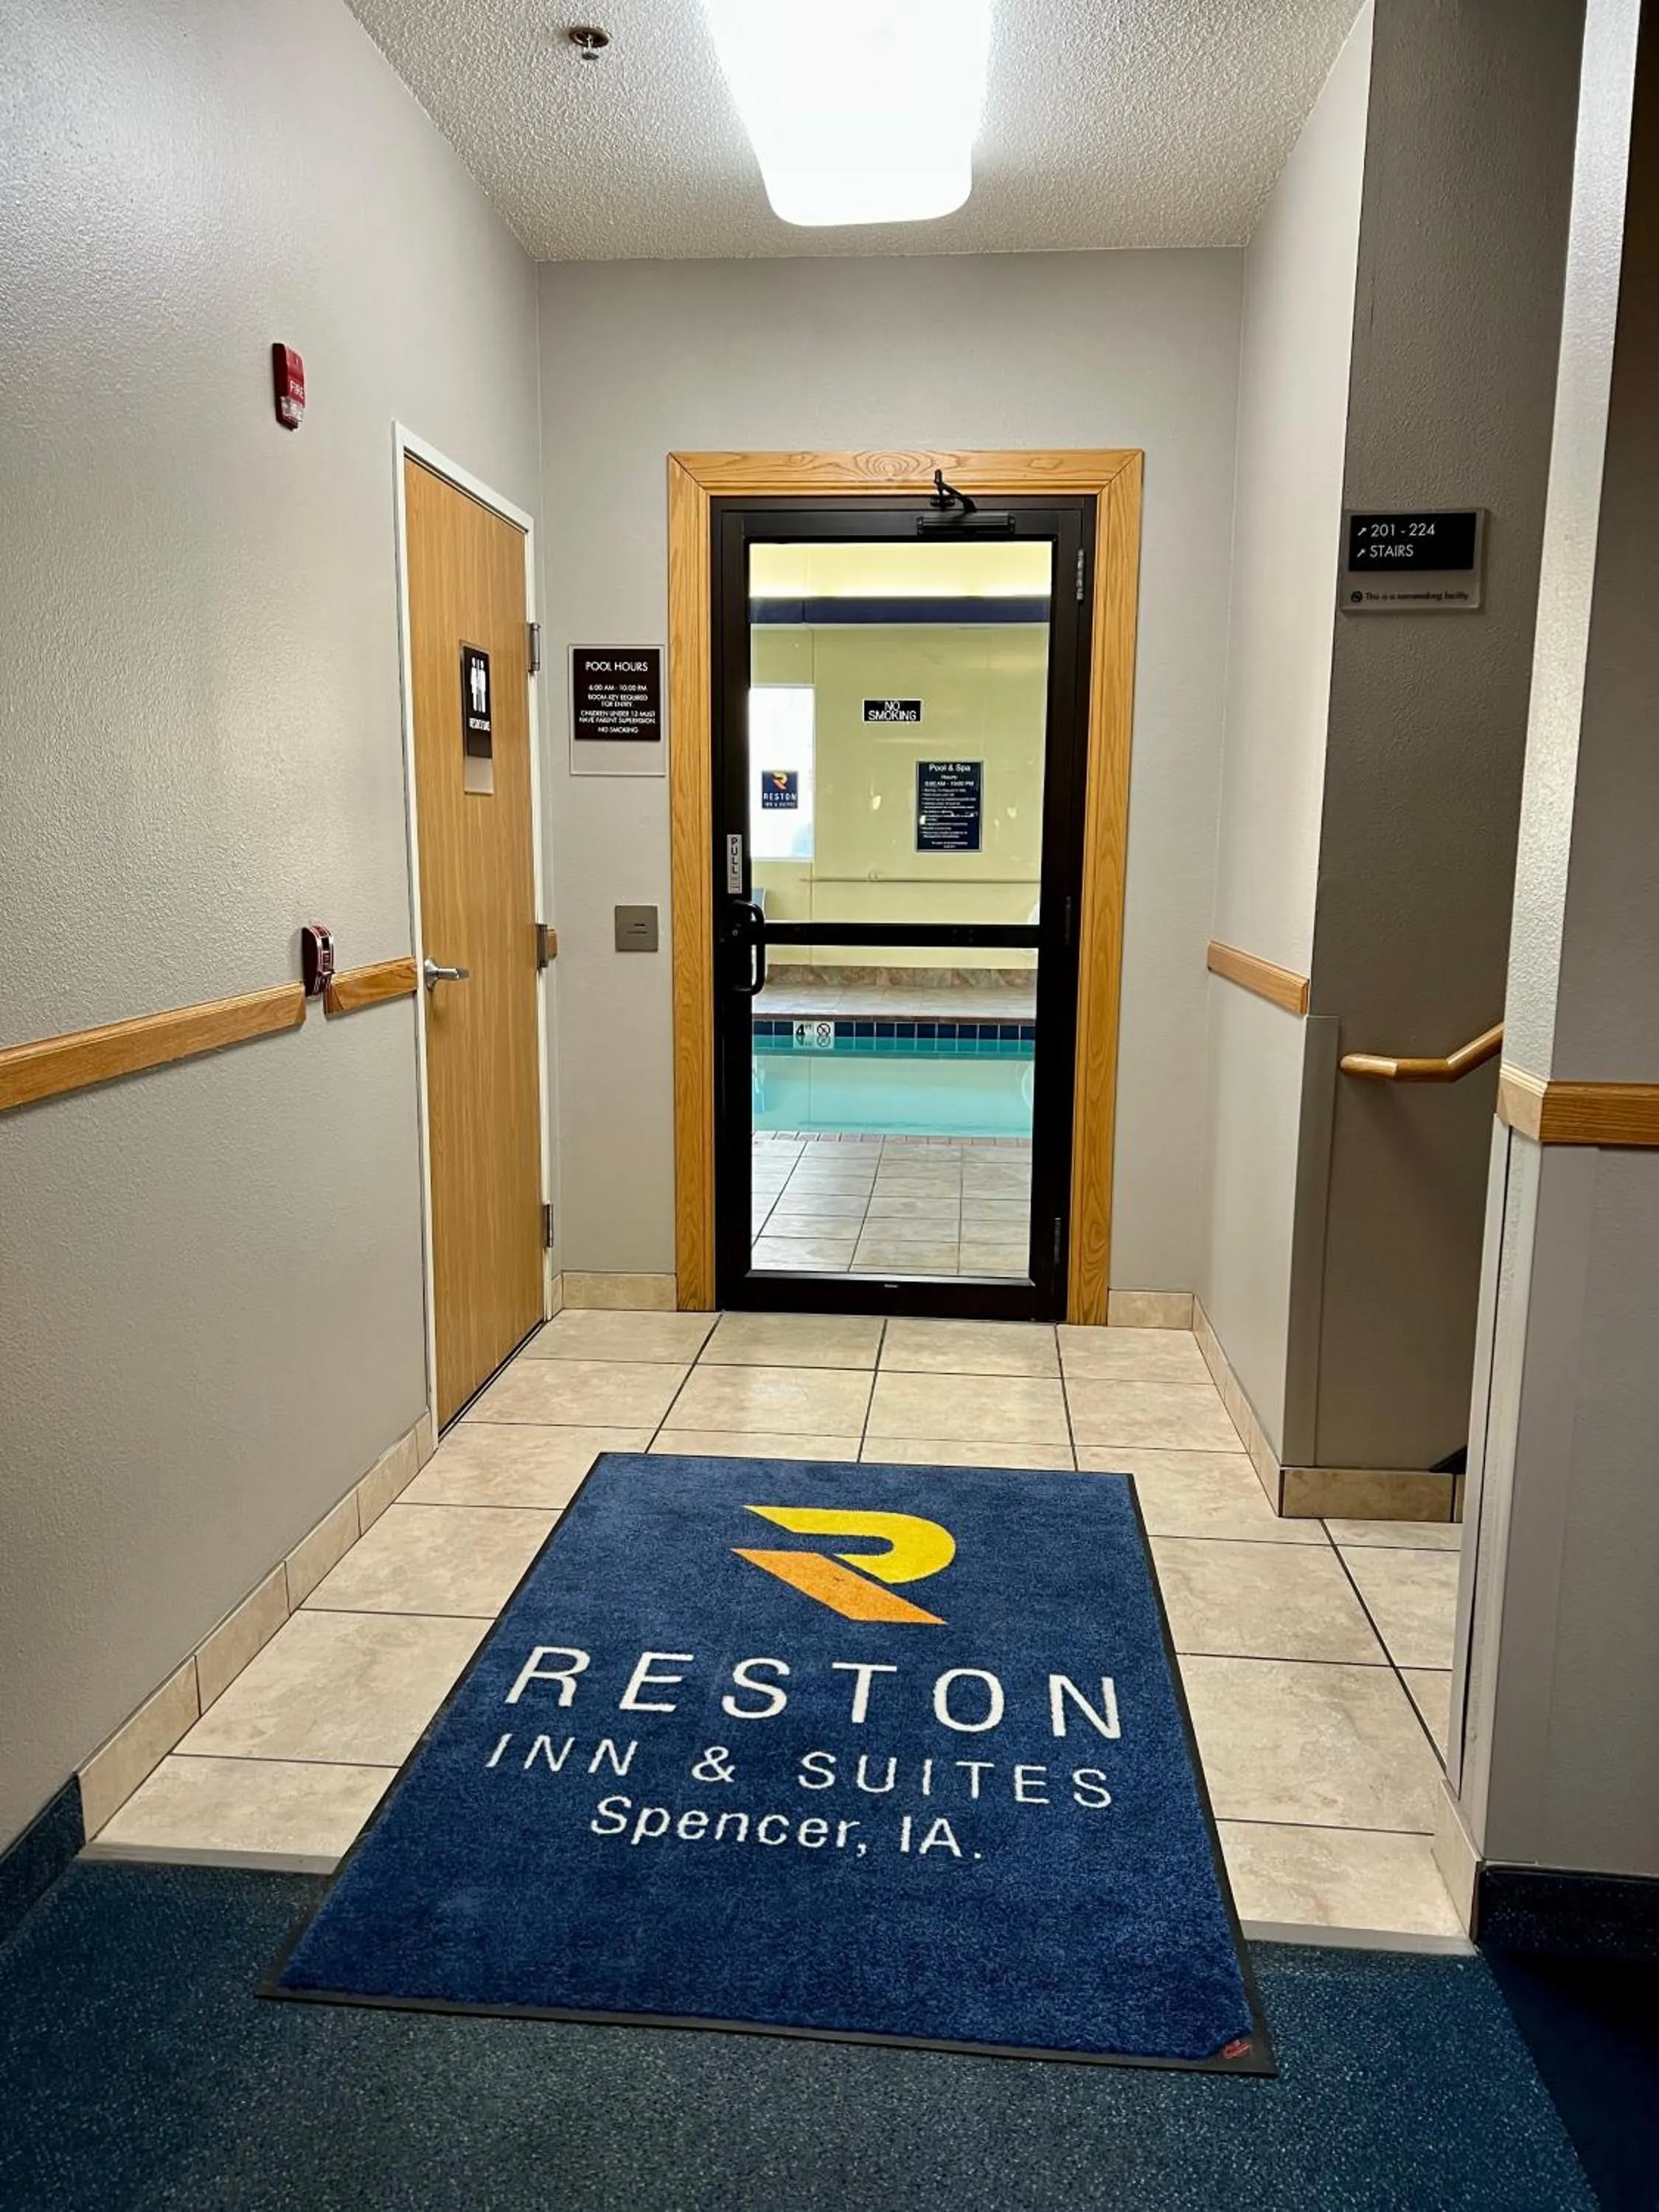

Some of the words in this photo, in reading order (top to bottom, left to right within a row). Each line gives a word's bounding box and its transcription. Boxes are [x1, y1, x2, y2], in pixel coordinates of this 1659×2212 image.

[1371, 524, 1396, 538] 201
[1409, 523, 1436, 536] 224
[1369, 545, 1413, 558] STAIRS
[585, 661, 612, 672] POOL
[614, 661, 648, 672] HOURS
[885, 701, 900, 711] NO
[868, 710, 917, 720] SMOKING
[929, 764, 947, 772] Pool
[948, 763, 954, 772] &
[956, 763, 971, 773] Spa
[763, 793, 796, 801] RESTON
[731, 837, 739, 874] PULL
[504, 1645, 1121, 1740] RESTON
[486, 1733, 639, 1776] INN
[692, 1746, 736, 1783] &
[798, 1751, 1113, 1809] SUITES
[591, 1795, 868, 1857] Spencer,
[900, 1815, 984, 1860] IA.
